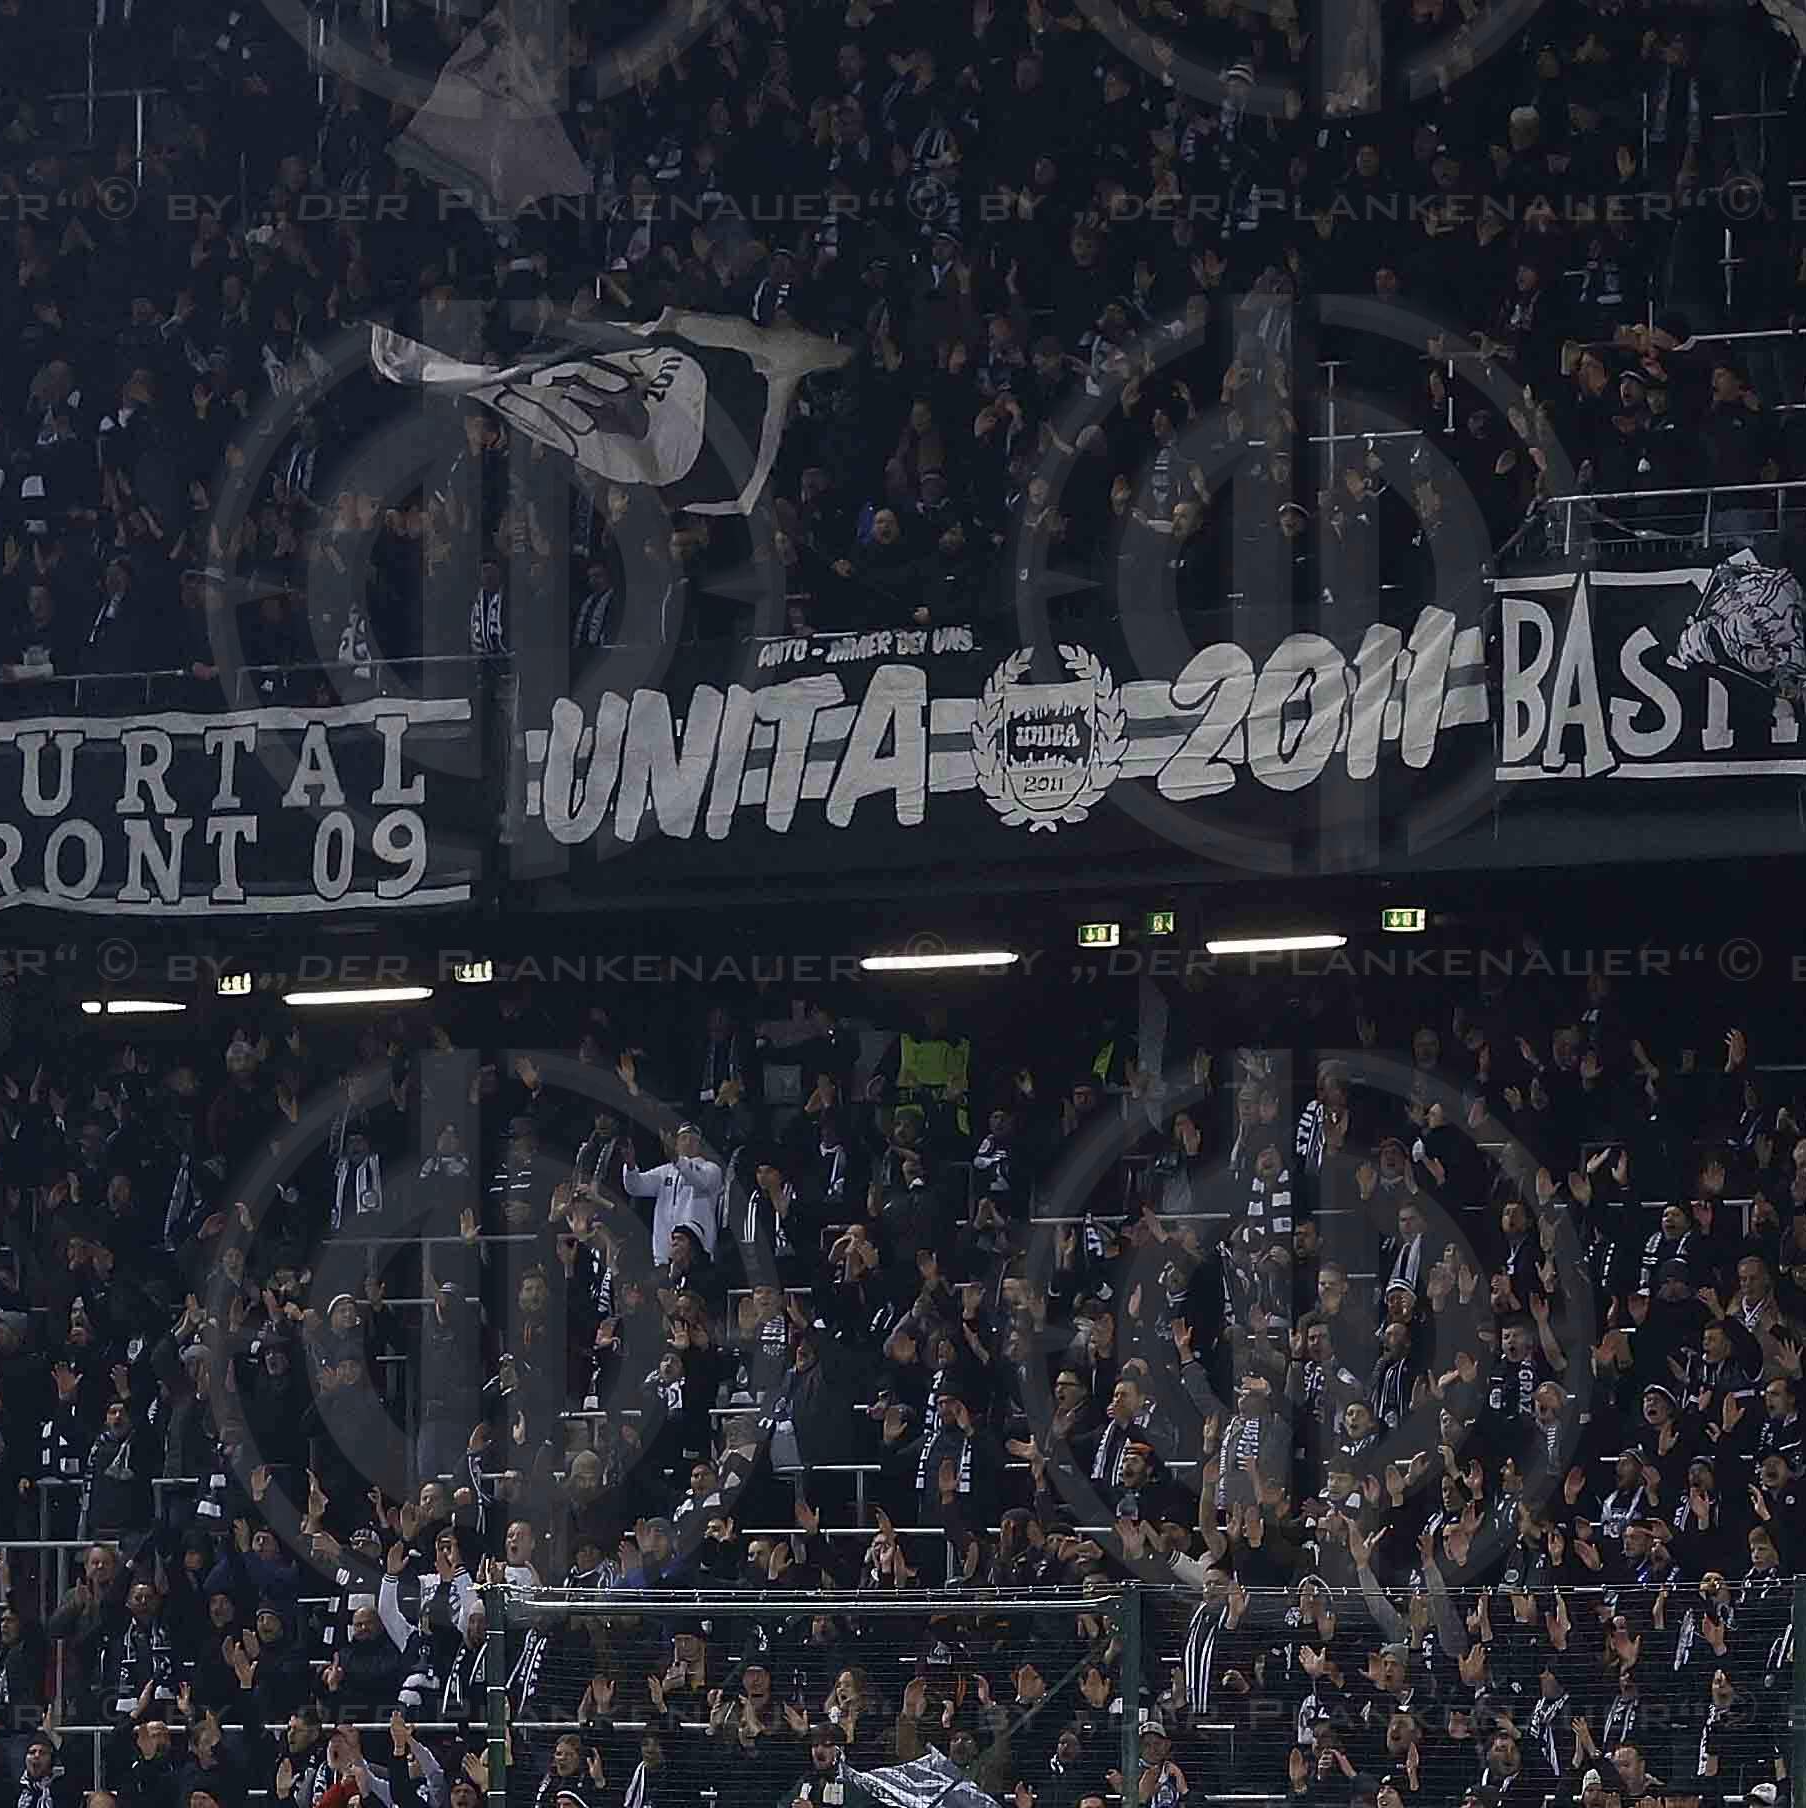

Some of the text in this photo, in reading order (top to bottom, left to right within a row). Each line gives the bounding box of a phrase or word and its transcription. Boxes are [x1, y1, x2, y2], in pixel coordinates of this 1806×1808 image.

[542, 603, 1456, 845] UNITA 2011
[1023, 775, 1064, 793] 2011
[310, 808, 429, 900] 09
